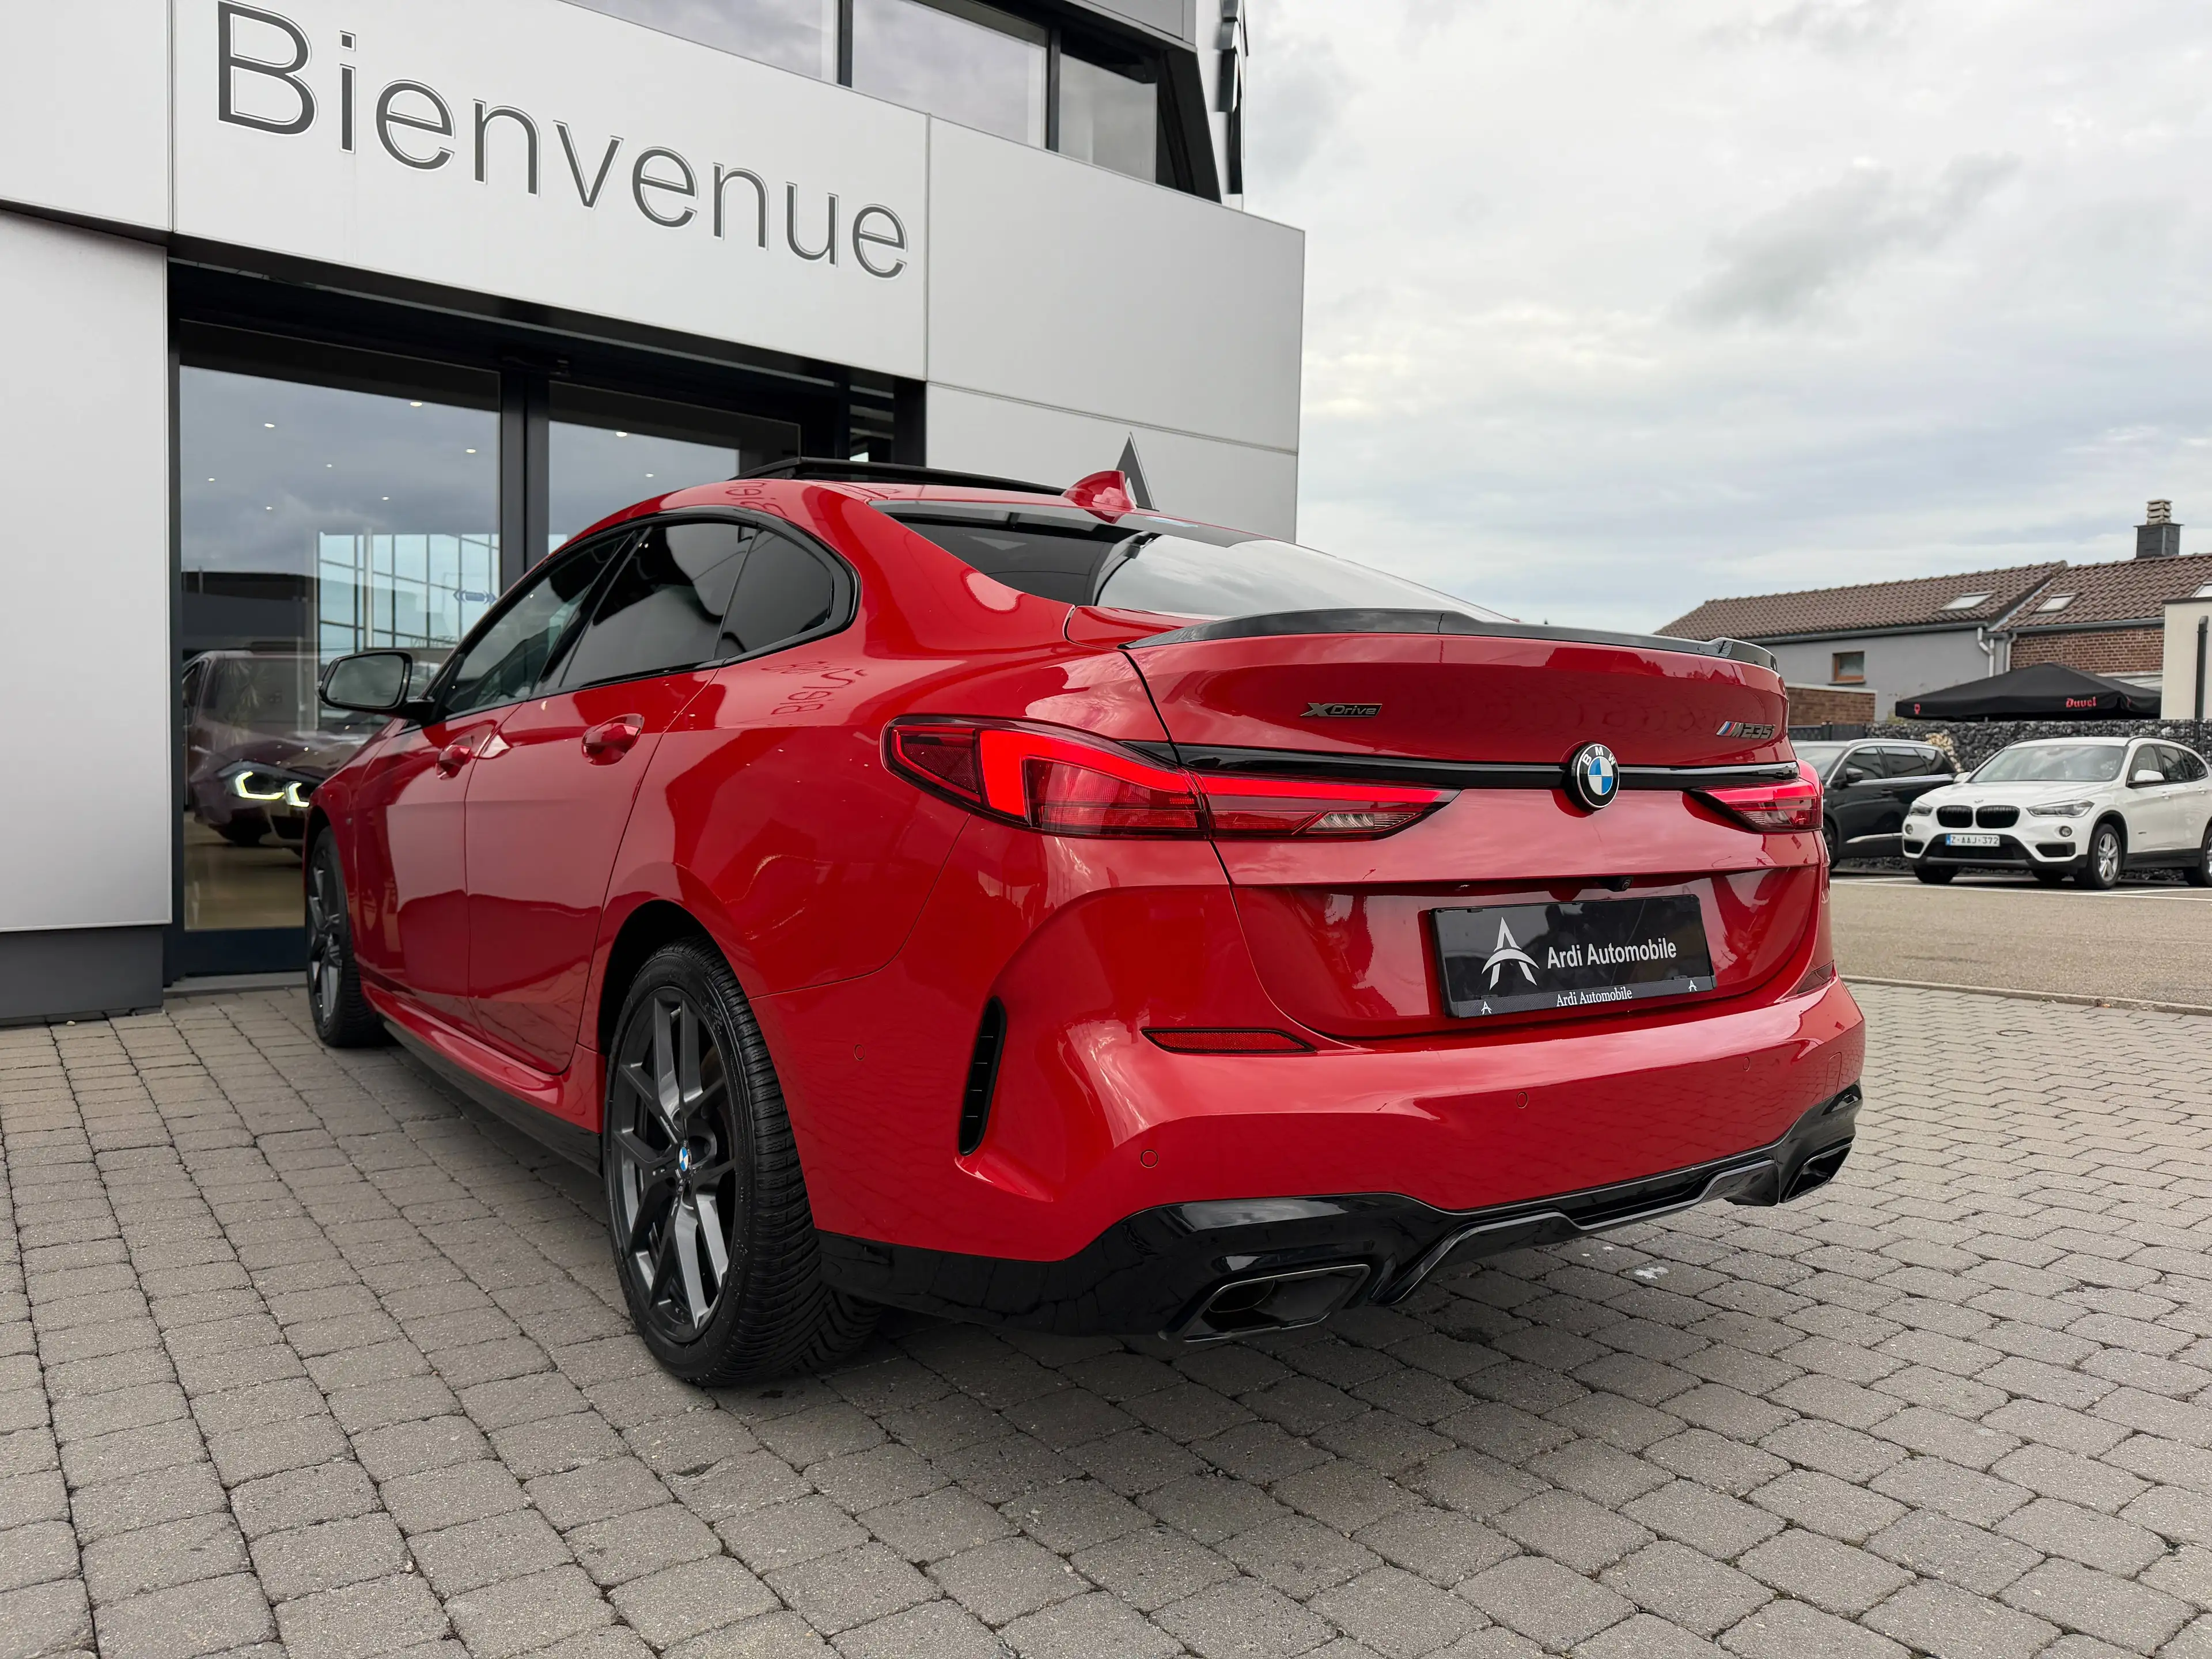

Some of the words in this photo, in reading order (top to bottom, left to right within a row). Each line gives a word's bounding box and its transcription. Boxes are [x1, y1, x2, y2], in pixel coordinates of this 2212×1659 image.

[218, 0, 907, 279] Bienvenue
[2066, 696, 2097, 708] Duvel
[1582, 746, 1616, 766] BMW
[1547, 945, 1583, 969] Ardi
[1588, 937, 1677, 965] Automobile
[1556, 991, 1578, 1007] Ardi
[1580, 986, 1633, 1005] Automobile
